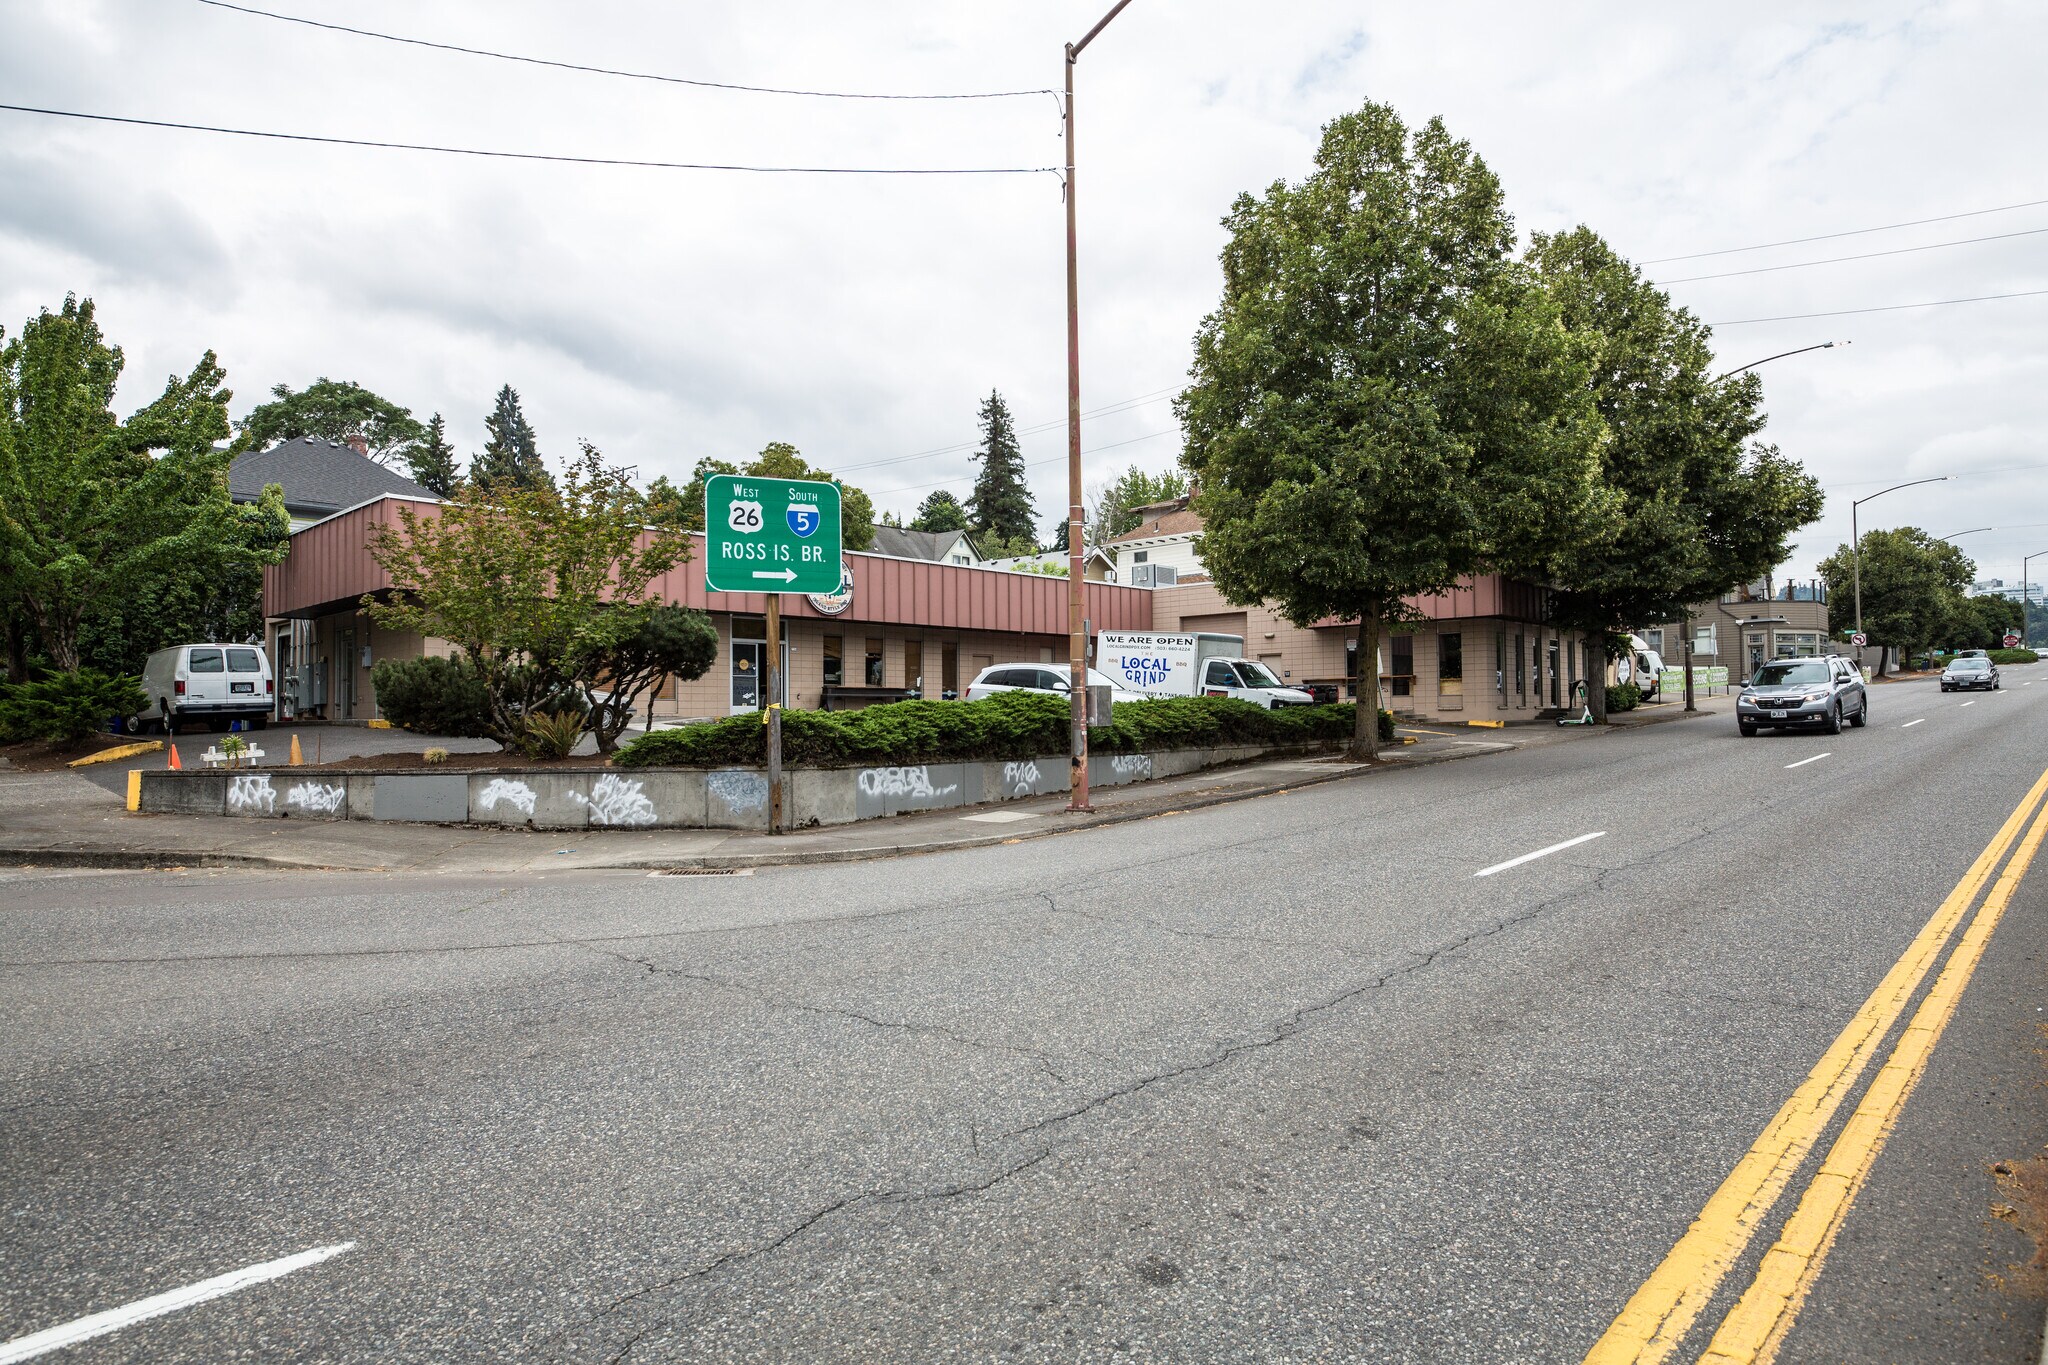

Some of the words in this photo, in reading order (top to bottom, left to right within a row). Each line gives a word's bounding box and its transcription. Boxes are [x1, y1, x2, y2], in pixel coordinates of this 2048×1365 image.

[733, 484, 759, 498] WEST
[788, 488, 818, 502] SOUTH
[733, 506, 759, 526] 26
[797, 512, 810, 531] 5
[722, 542, 766, 560] ROSS
[774, 544, 794, 562] IS.
[802, 546, 826, 562] BR.
[1122, 656, 1171, 672] LOCAL
[1126, 670, 1166, 687] GRIND
